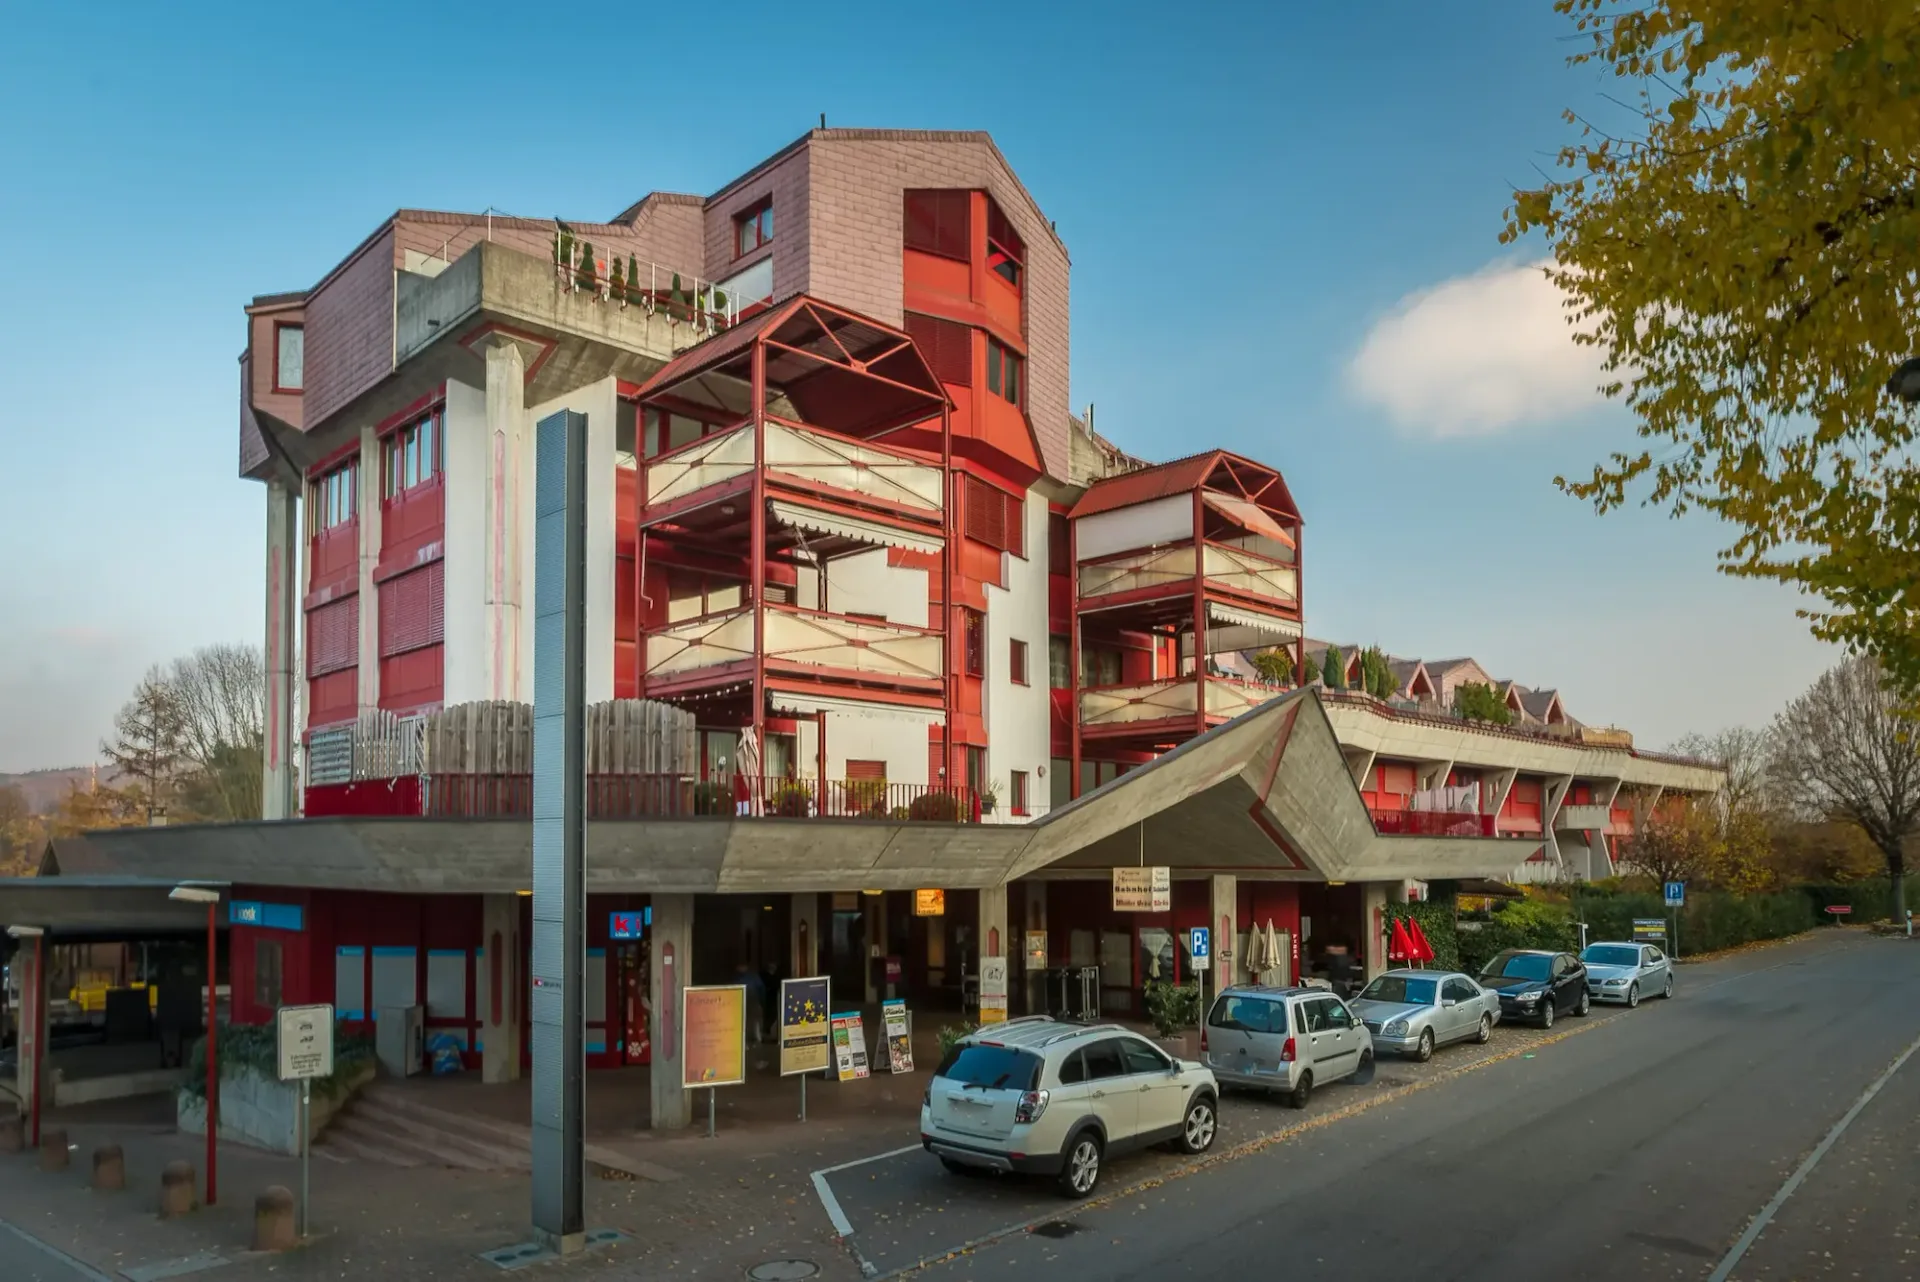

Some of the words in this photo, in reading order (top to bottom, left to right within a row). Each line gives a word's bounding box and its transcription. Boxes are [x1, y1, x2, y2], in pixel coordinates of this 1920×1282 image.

[1115, 885, 1152, 893] Bahnhof
[1670, 884, 1678, 898] P
[614, 914, 629, 932] k
[1194, 931, 1202, 953] P
